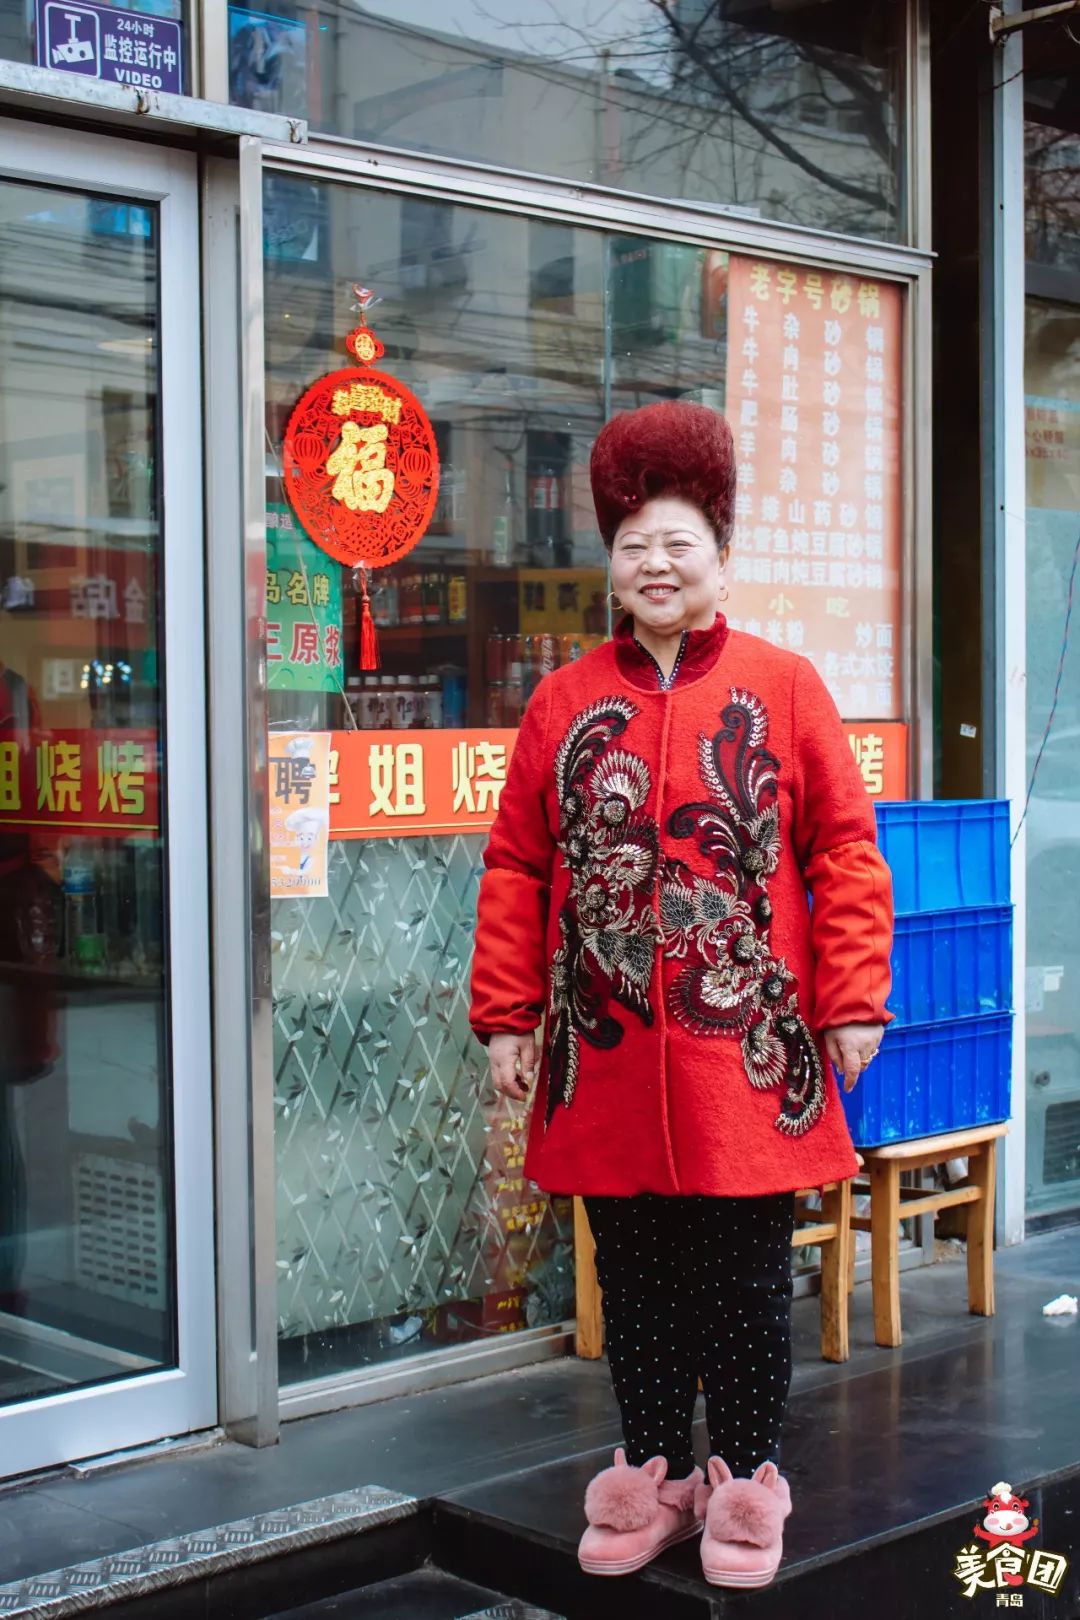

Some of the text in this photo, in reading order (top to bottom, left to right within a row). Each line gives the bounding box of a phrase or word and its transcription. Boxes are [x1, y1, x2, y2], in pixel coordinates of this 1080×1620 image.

[117, 18, 155, 38] 24小时
[104, 34, 177, 72] 监控运行中
[115, 68, 162, 89] VIDEO
[326, 421, 395, 514] 福
[768, 592, 851, 618] 小吃
